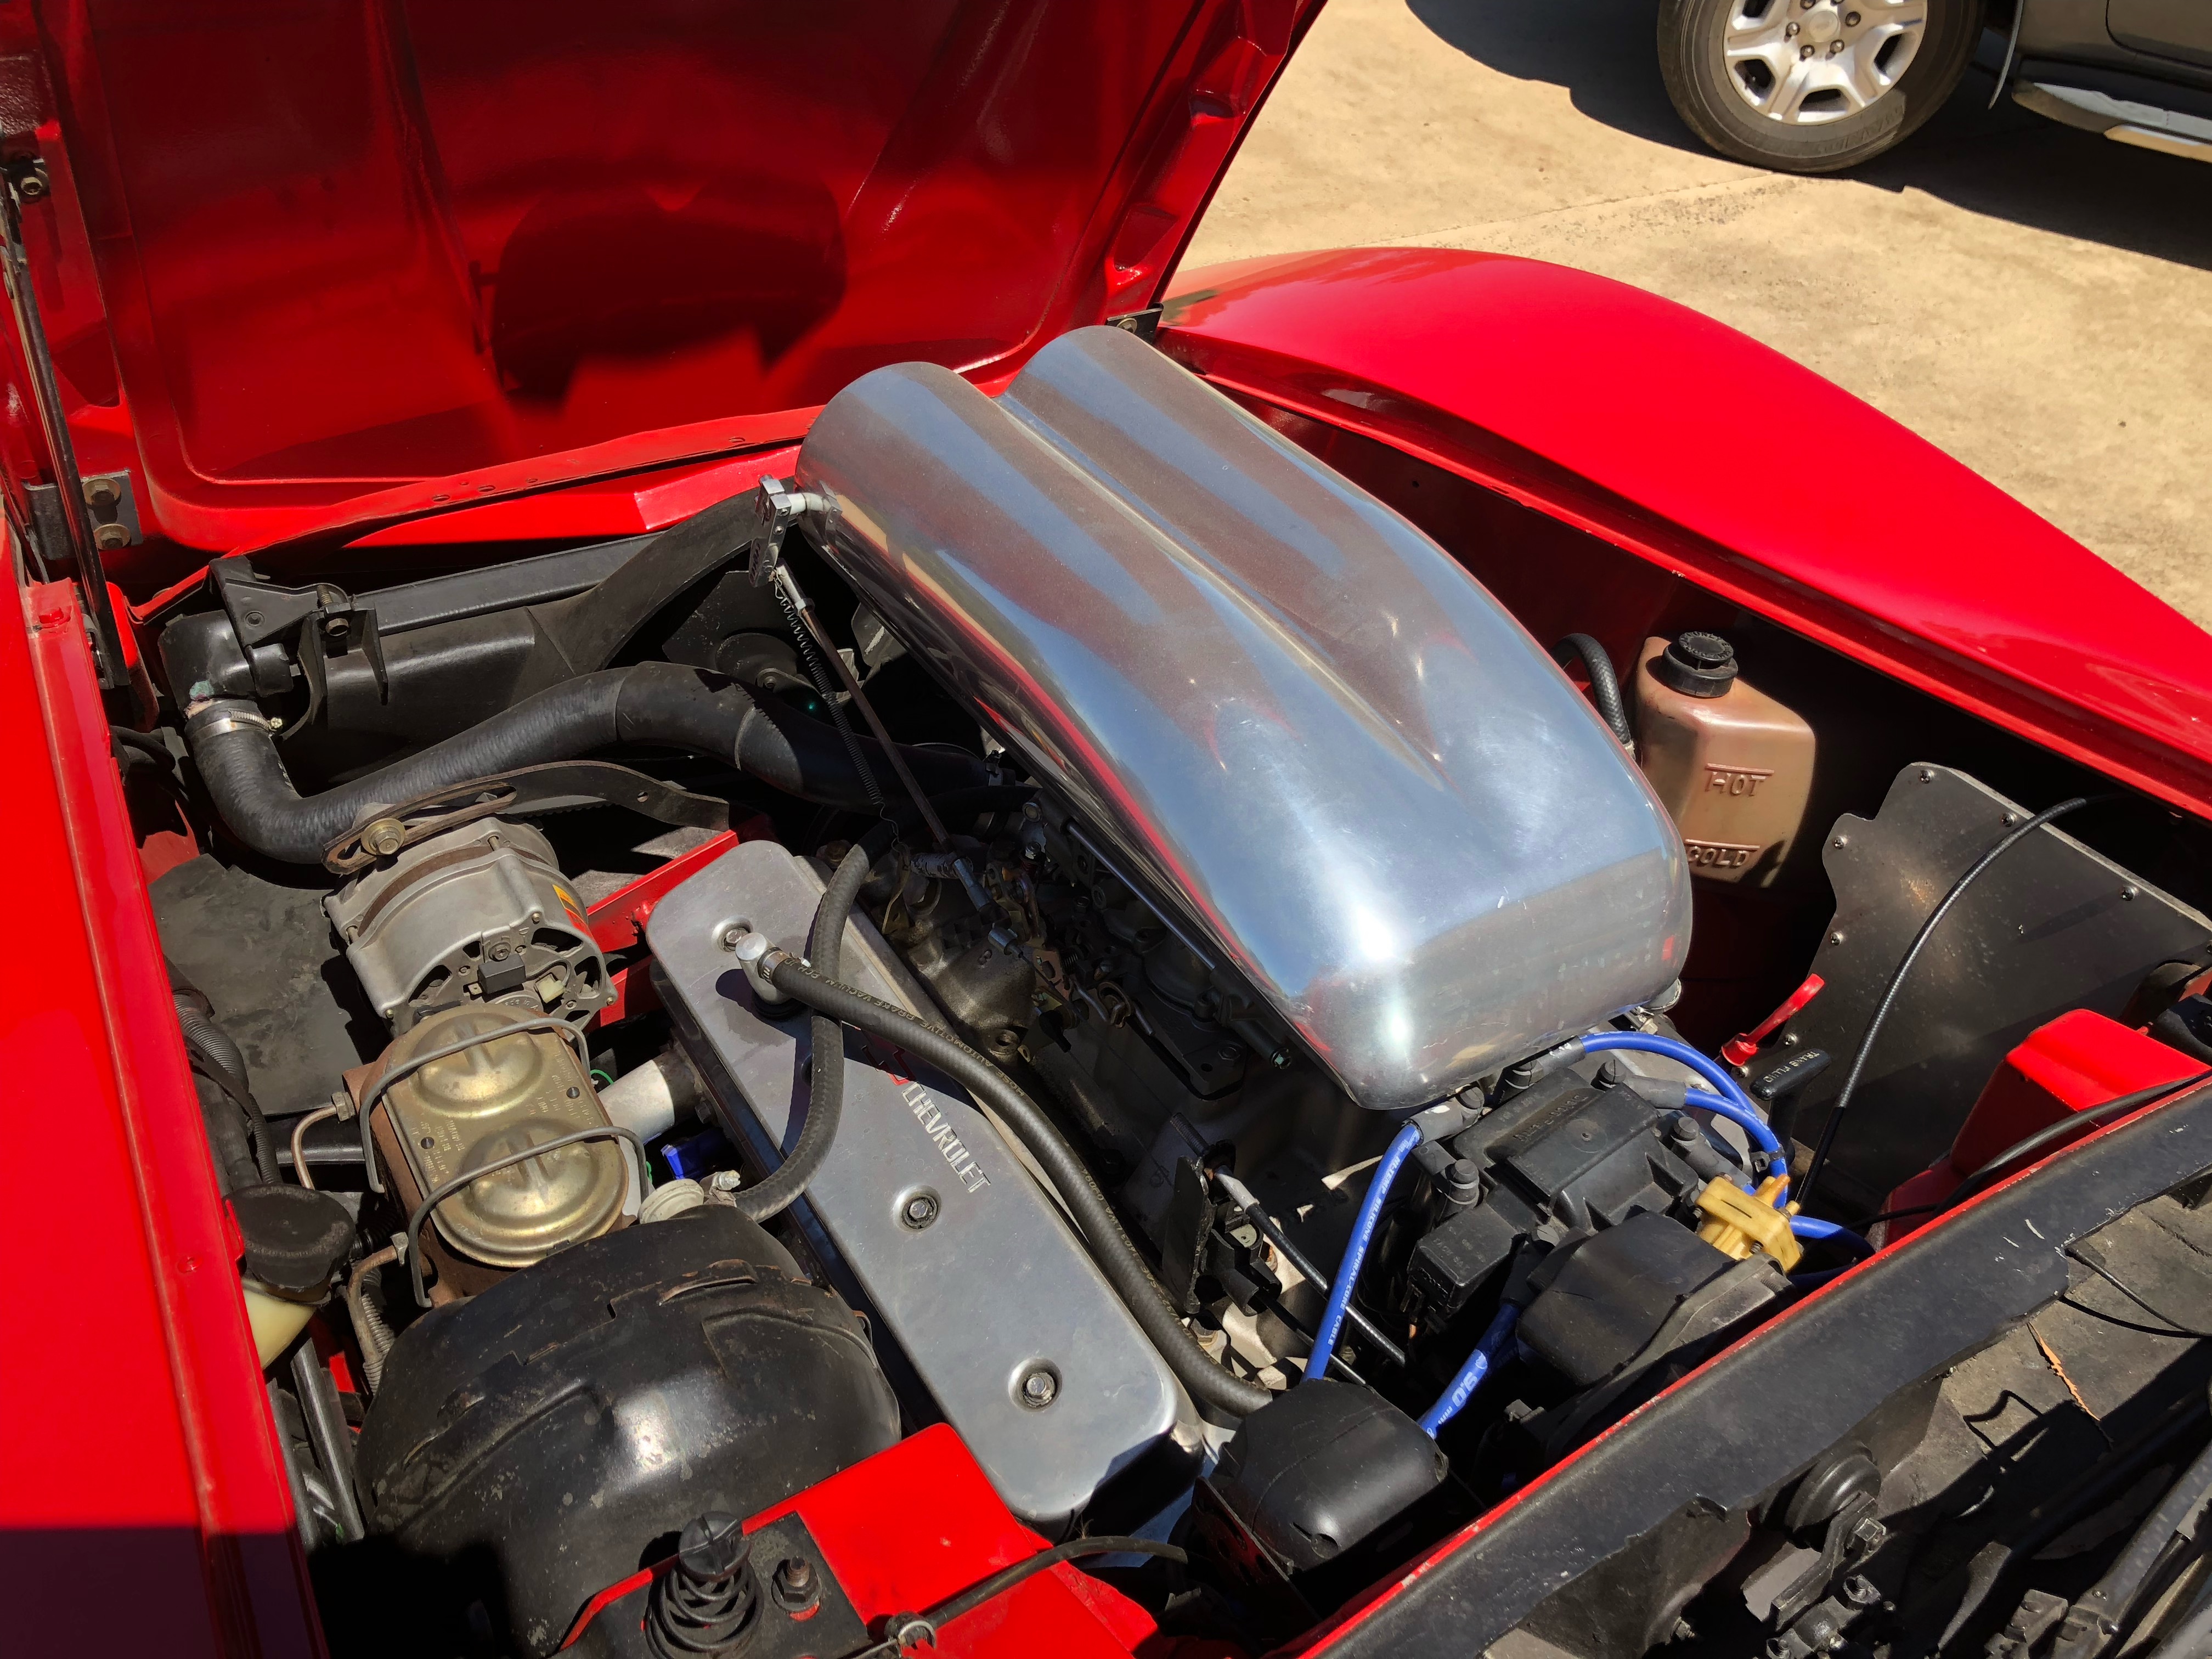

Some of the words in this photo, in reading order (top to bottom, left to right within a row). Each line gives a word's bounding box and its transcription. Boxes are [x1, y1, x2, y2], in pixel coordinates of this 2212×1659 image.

[1705, 771, 1766, 797] HOT
[1687, 846, 1750, 866] COLD
[825, 977, 873, 1003] VACUUM
[873, 997, 916, 1022] BRAKE
[918, 1018, 994, 1069] AUTOMOTIVE
[1763, 1065, 1791, 1083] FLUID
[1789, 1051, 1820, 1067] TRANS
[995, 1068, 1026, 1097] HOSE
[901, 1081, 991, 1193] CHEVROLET
[1378, 1155, 1401, 1194] HI-TEMP
[1360, 1197, 1384, 1242] SILICONE
[1338, 1245, 1365, 1310] SPIRAL-CORE
[1326, 1314, 1342, 1346] CABLE
[1451, 1370, 1479, 1407] 9.0
